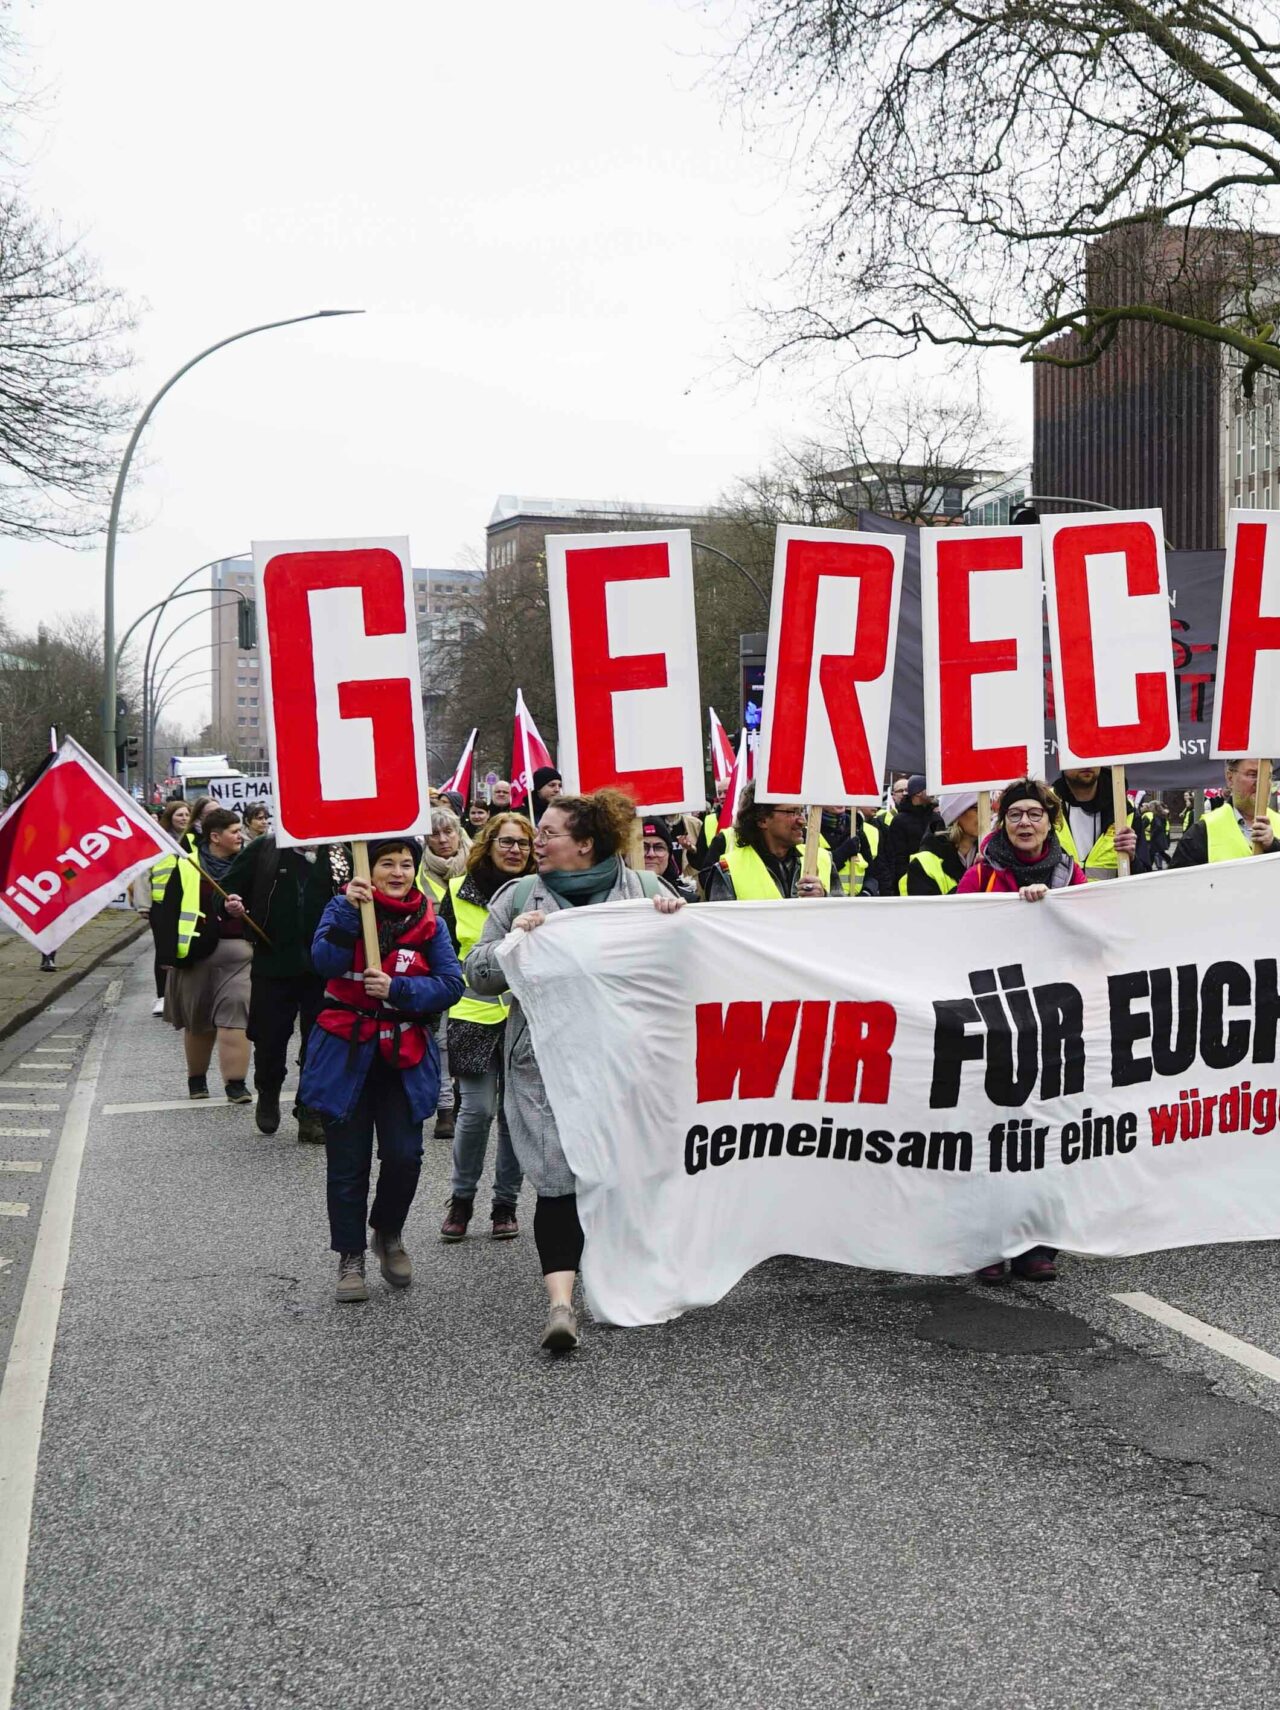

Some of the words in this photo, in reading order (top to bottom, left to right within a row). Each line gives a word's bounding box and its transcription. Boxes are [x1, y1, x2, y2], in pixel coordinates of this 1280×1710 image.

[211, 783, 273, 799] NIEMA
[696, 1000, 897, 1104] WIR
[929, 964, 1086, 1110] FÜR
[684, 1117, 973, 1176] Gemeinsam
[988, 1119, 1049, 1173] für
[1060, 1108, 1138, 1165] eine
